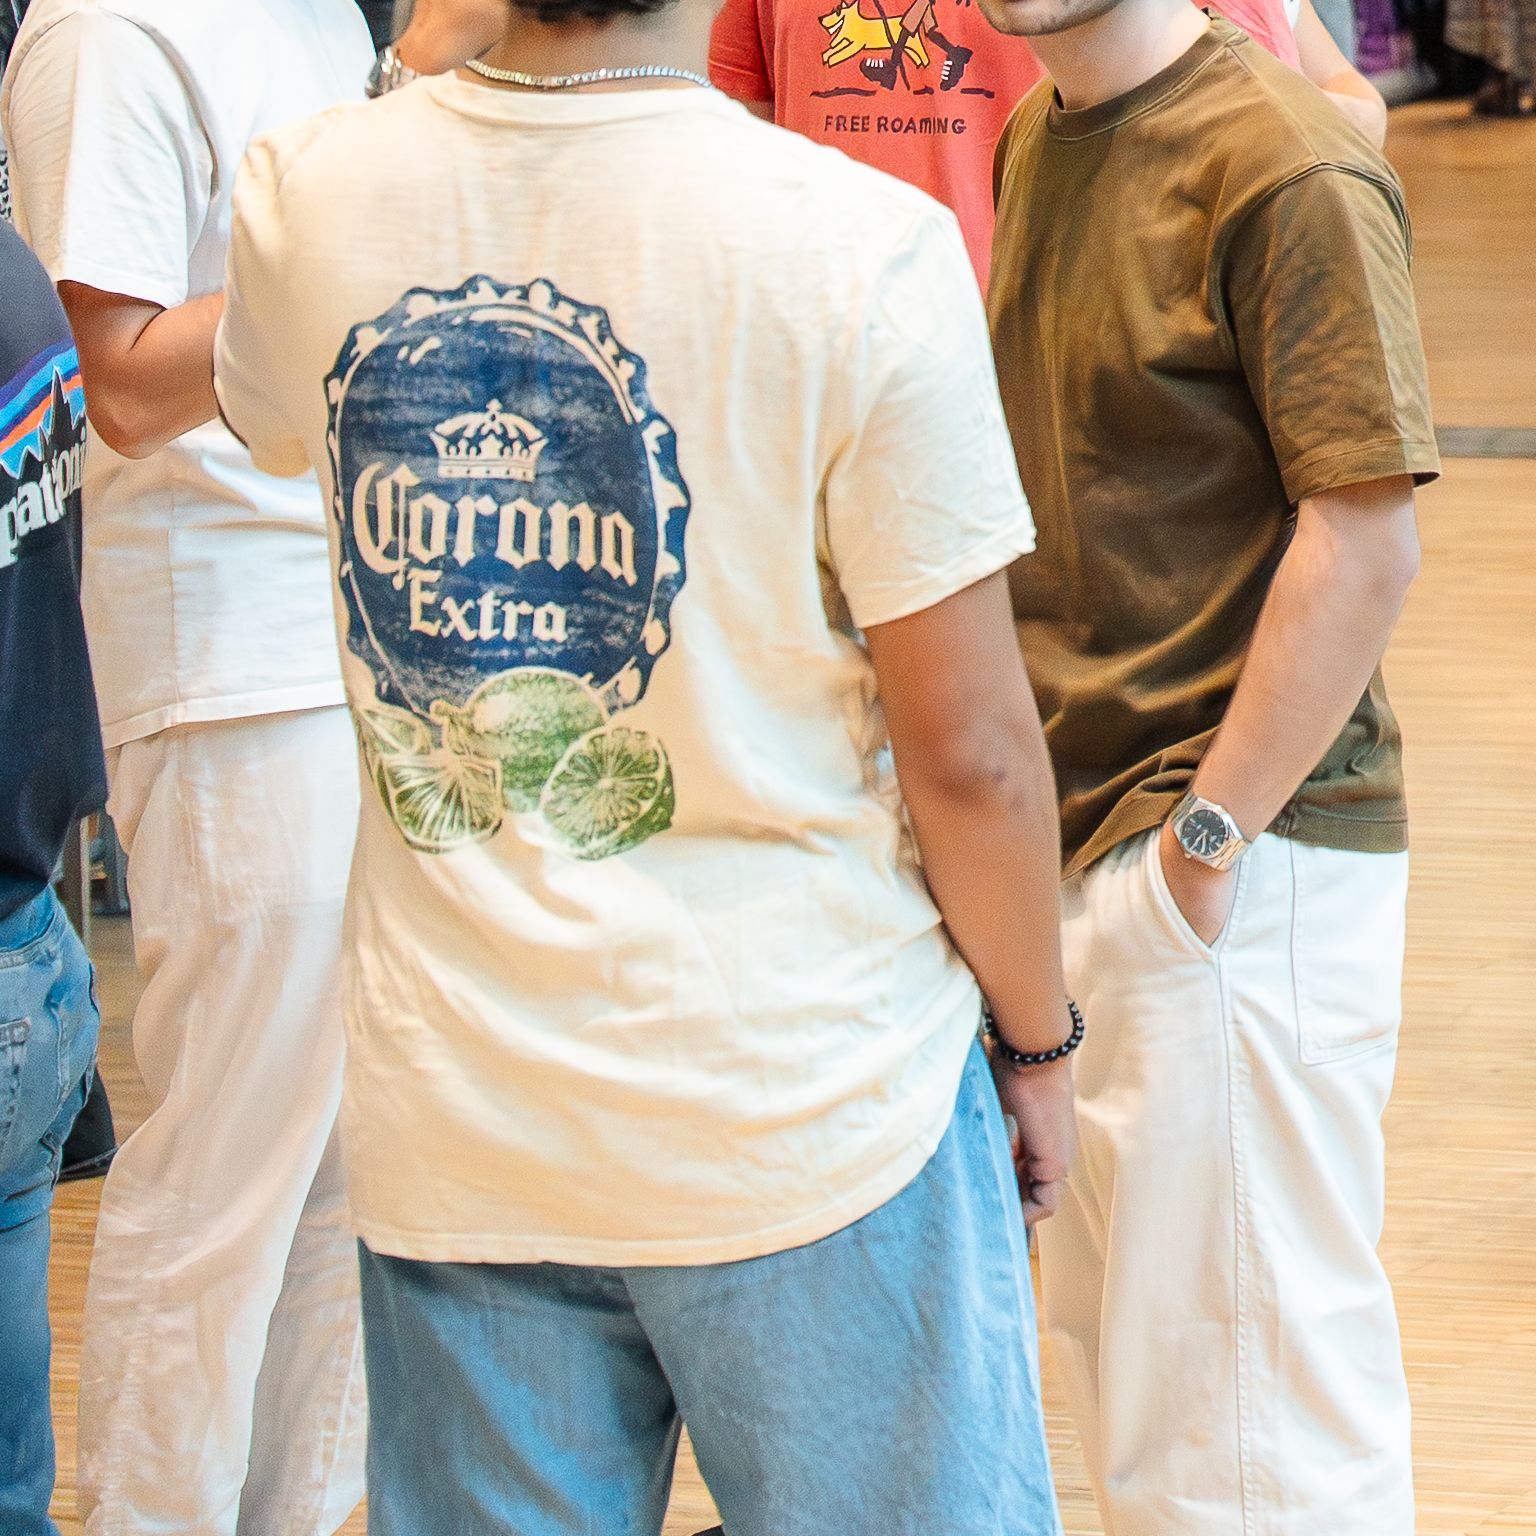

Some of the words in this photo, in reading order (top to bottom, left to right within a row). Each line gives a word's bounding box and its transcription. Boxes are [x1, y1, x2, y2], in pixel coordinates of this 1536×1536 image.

[824, 115, 870, 132] FREE
[877, 116, 967, 136] ROAMING
[352, 462, 638, 591] Corona
[408, 567, 569, 644] Extra
